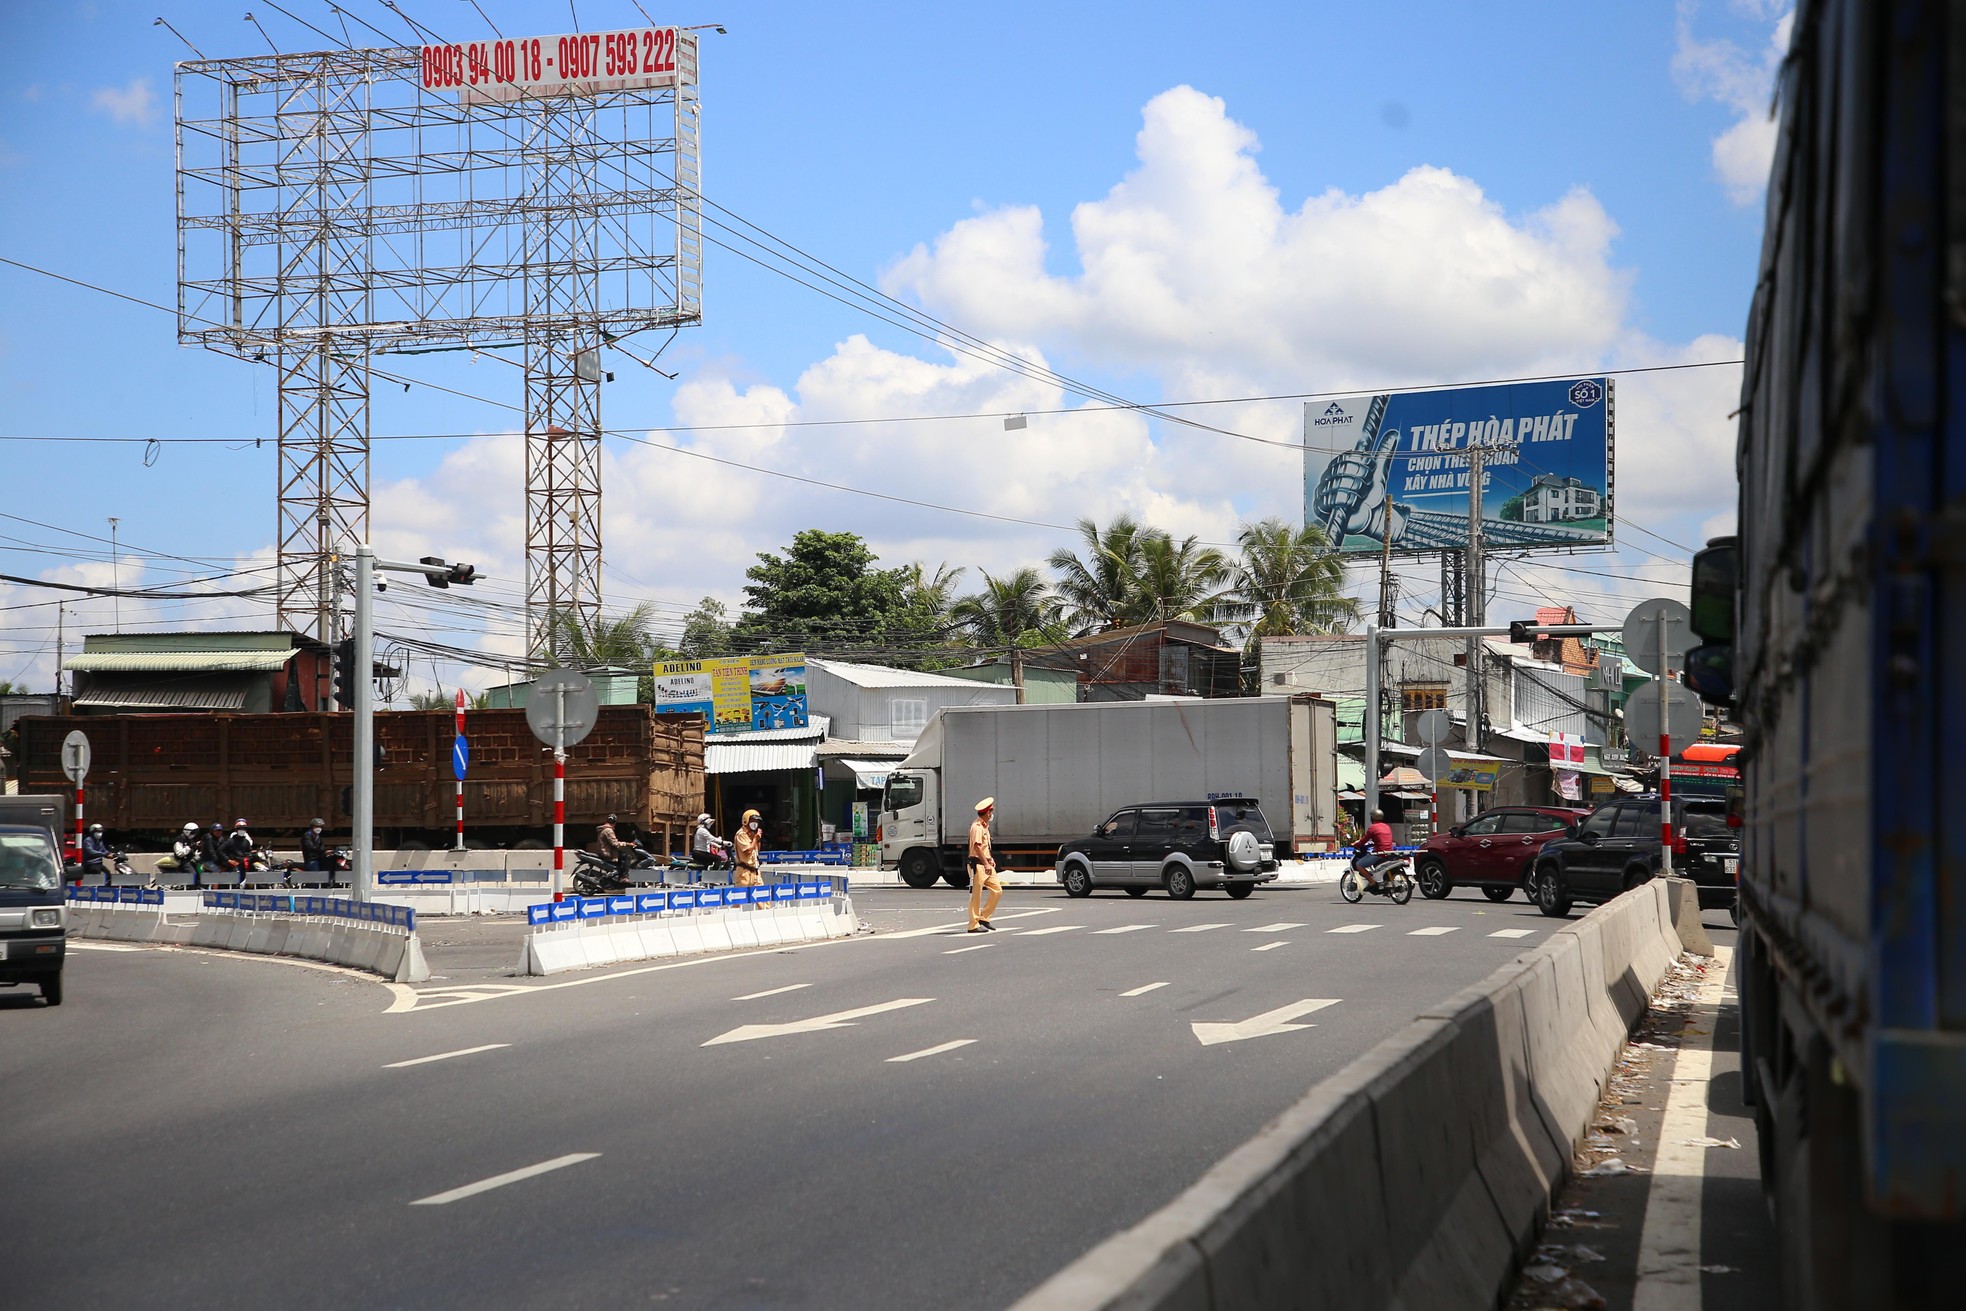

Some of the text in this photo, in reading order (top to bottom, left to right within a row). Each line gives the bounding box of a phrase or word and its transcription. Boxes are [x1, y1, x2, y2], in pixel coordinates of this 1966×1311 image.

[423, 44, 463, 88] 0903
[469, 43, 490, 85] 94
[495, 40, 515, 83] 00
[521, 38, 542, 81] 18
[559, 35, 600, 79] 0907
[606, 32, 637, 76] 593
[643, 28, 675, 73] 222
[1590, 390, 1595, 398] 1
[1411, 410, 1578, 451] THÉP HÒA PHÁT
[1407, 457, 1440, 475] CHỌN
[1404, 474, 1428, 491] XÂY
[1429, 471, 1454, 489] NHÀ
[663, 662, 702, 673] ADELINO
[670, 677, 695, 685] ADELINO
